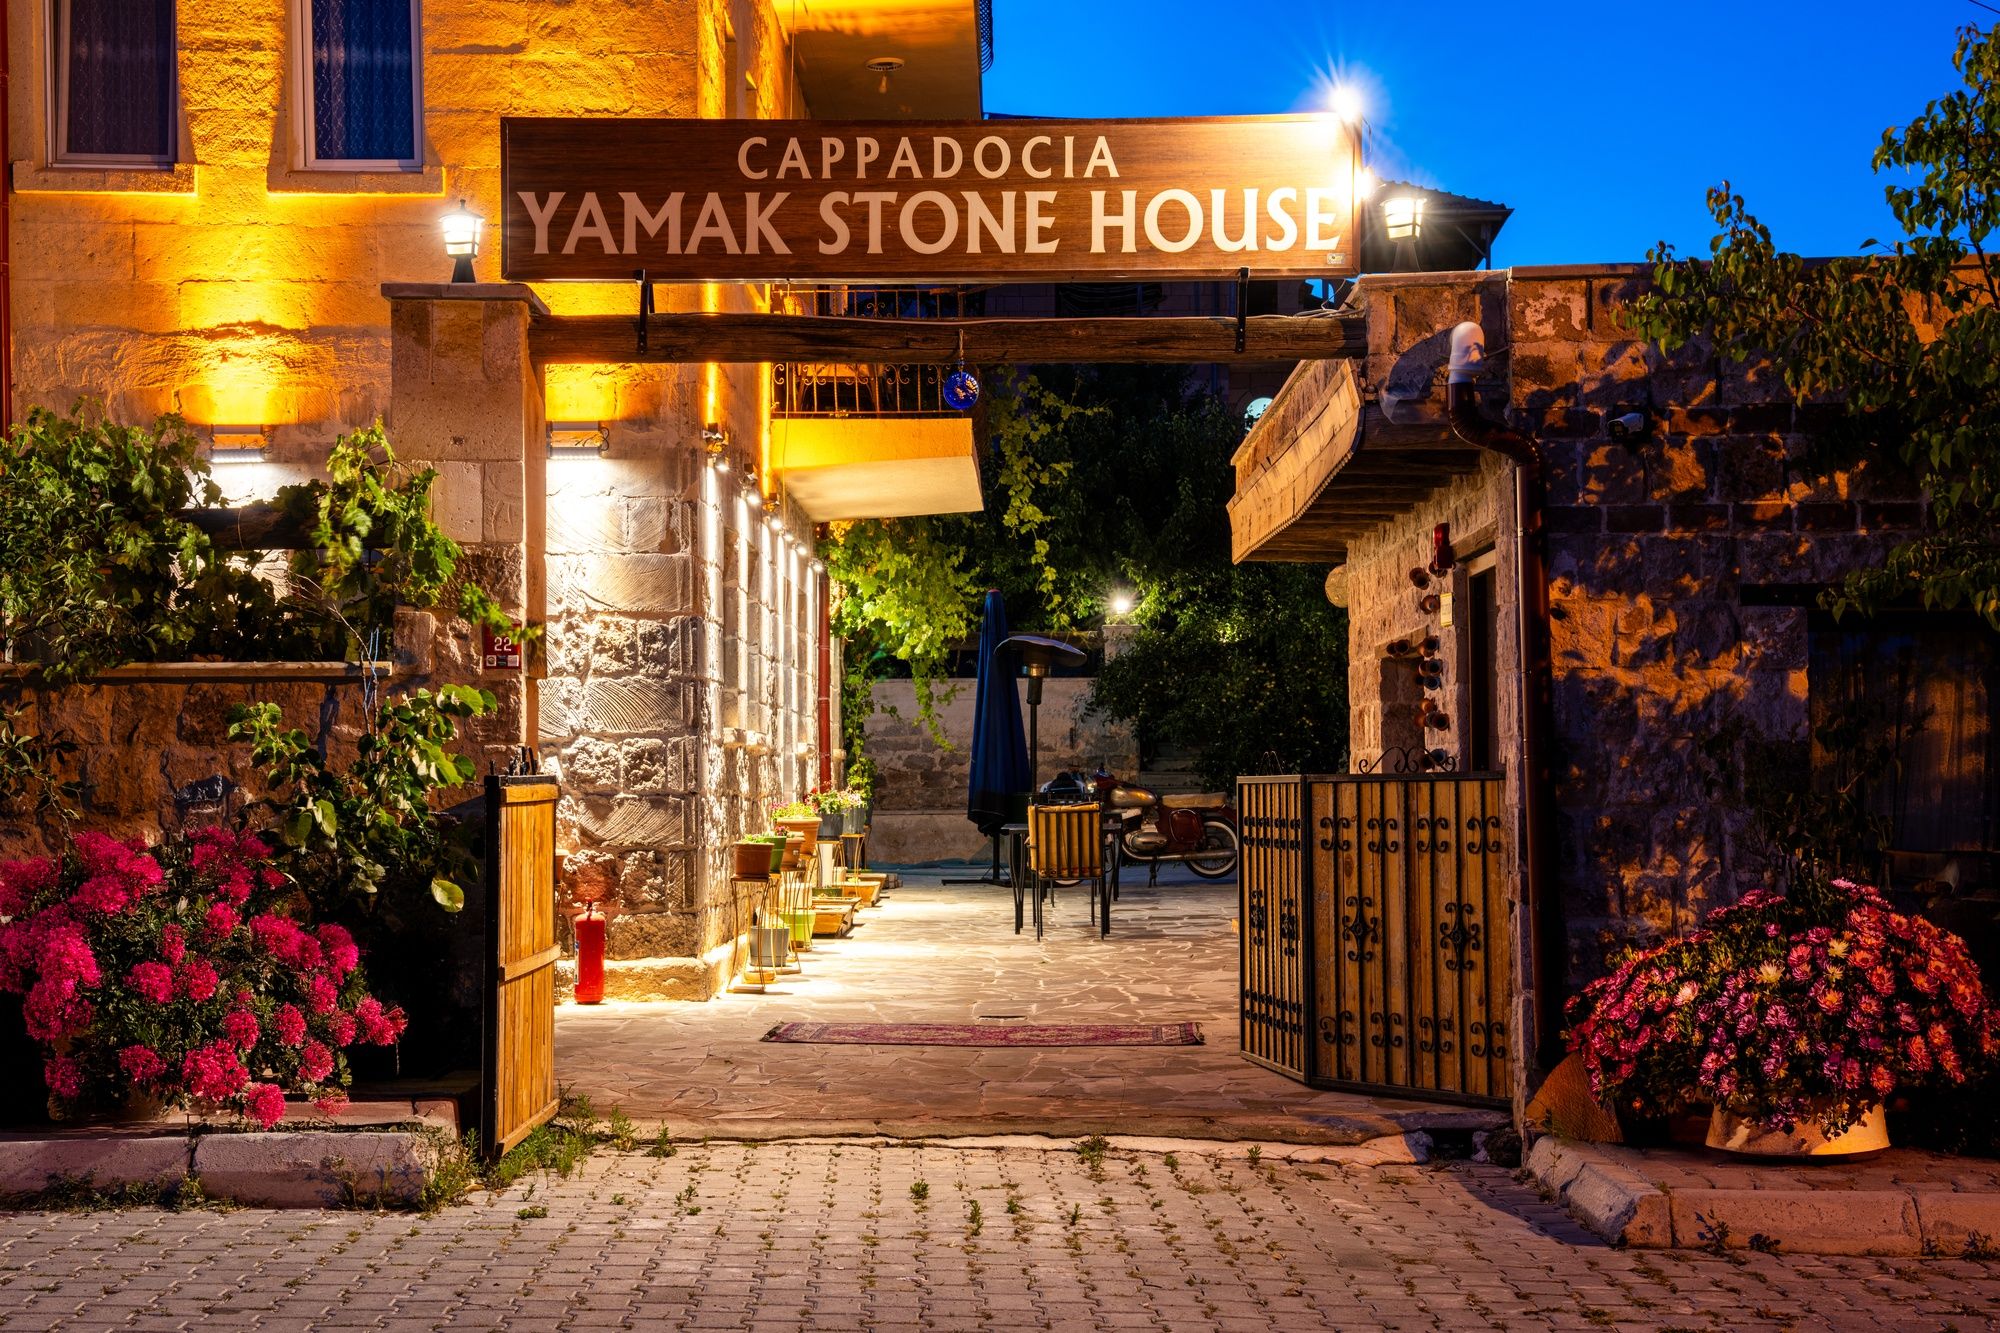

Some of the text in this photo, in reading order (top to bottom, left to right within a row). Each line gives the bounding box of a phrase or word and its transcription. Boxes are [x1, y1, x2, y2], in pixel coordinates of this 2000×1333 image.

[738, 136, 1120, 179] CAPPADOCIA
[516, 187, 1341, 255] YAMAK STONE HOUSE
[494, 636, 512, 652] 22
